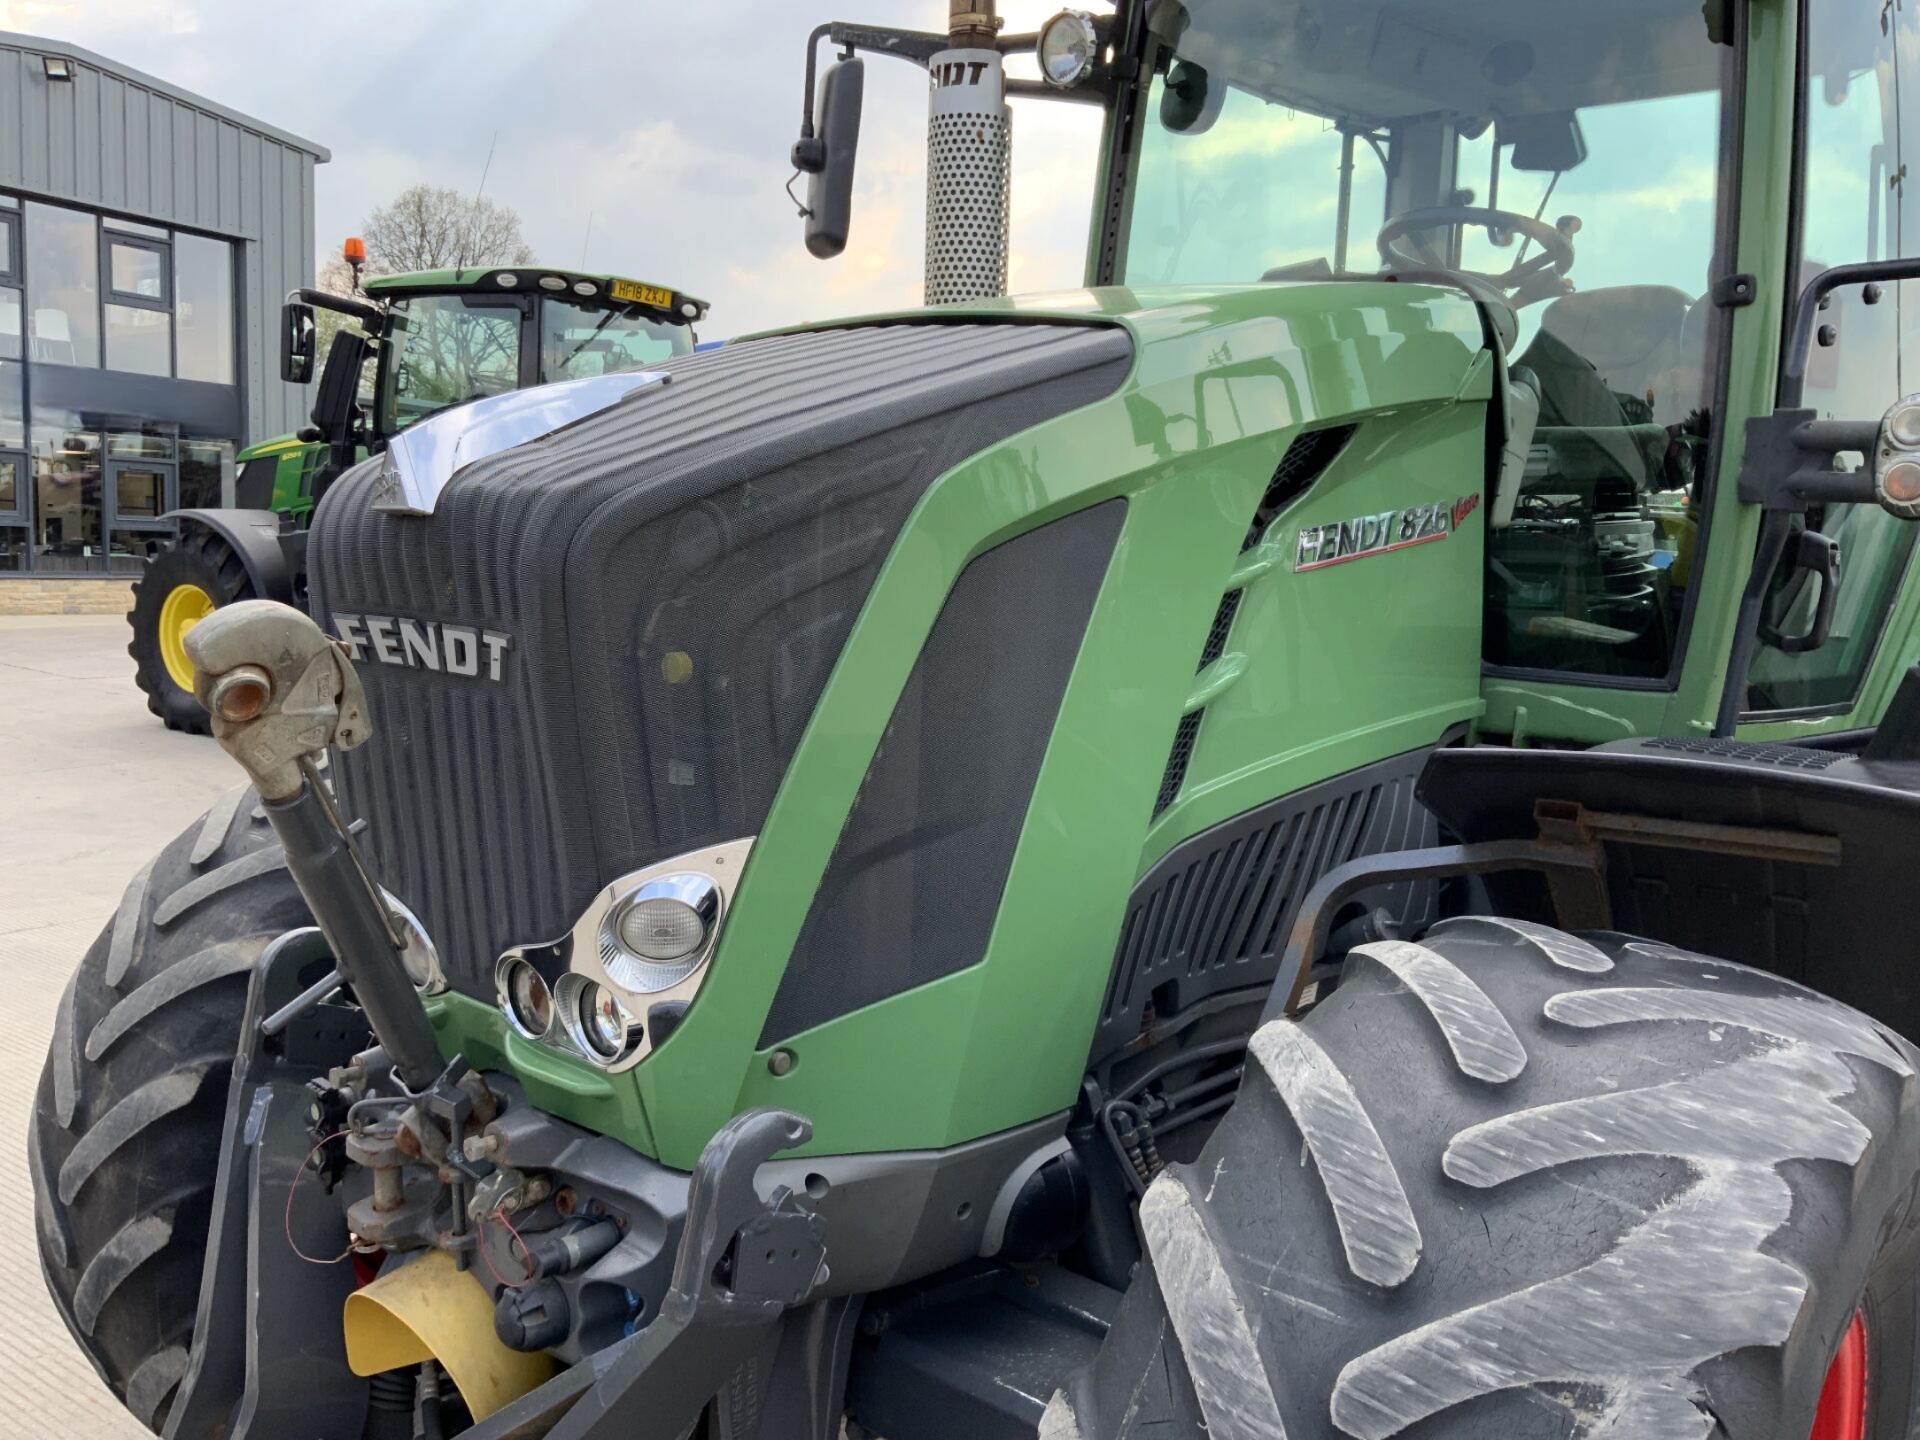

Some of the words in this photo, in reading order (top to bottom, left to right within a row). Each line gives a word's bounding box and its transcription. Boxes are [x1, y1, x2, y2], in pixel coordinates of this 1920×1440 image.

[618, 281, 642, 300] HF18
[644, 286, 666, 304] ZXJ
[1297, 511, 1396, 565] FENDT
[1399, 500, 1449, 541] 826
[332, 612, 513, 682] FENDT
